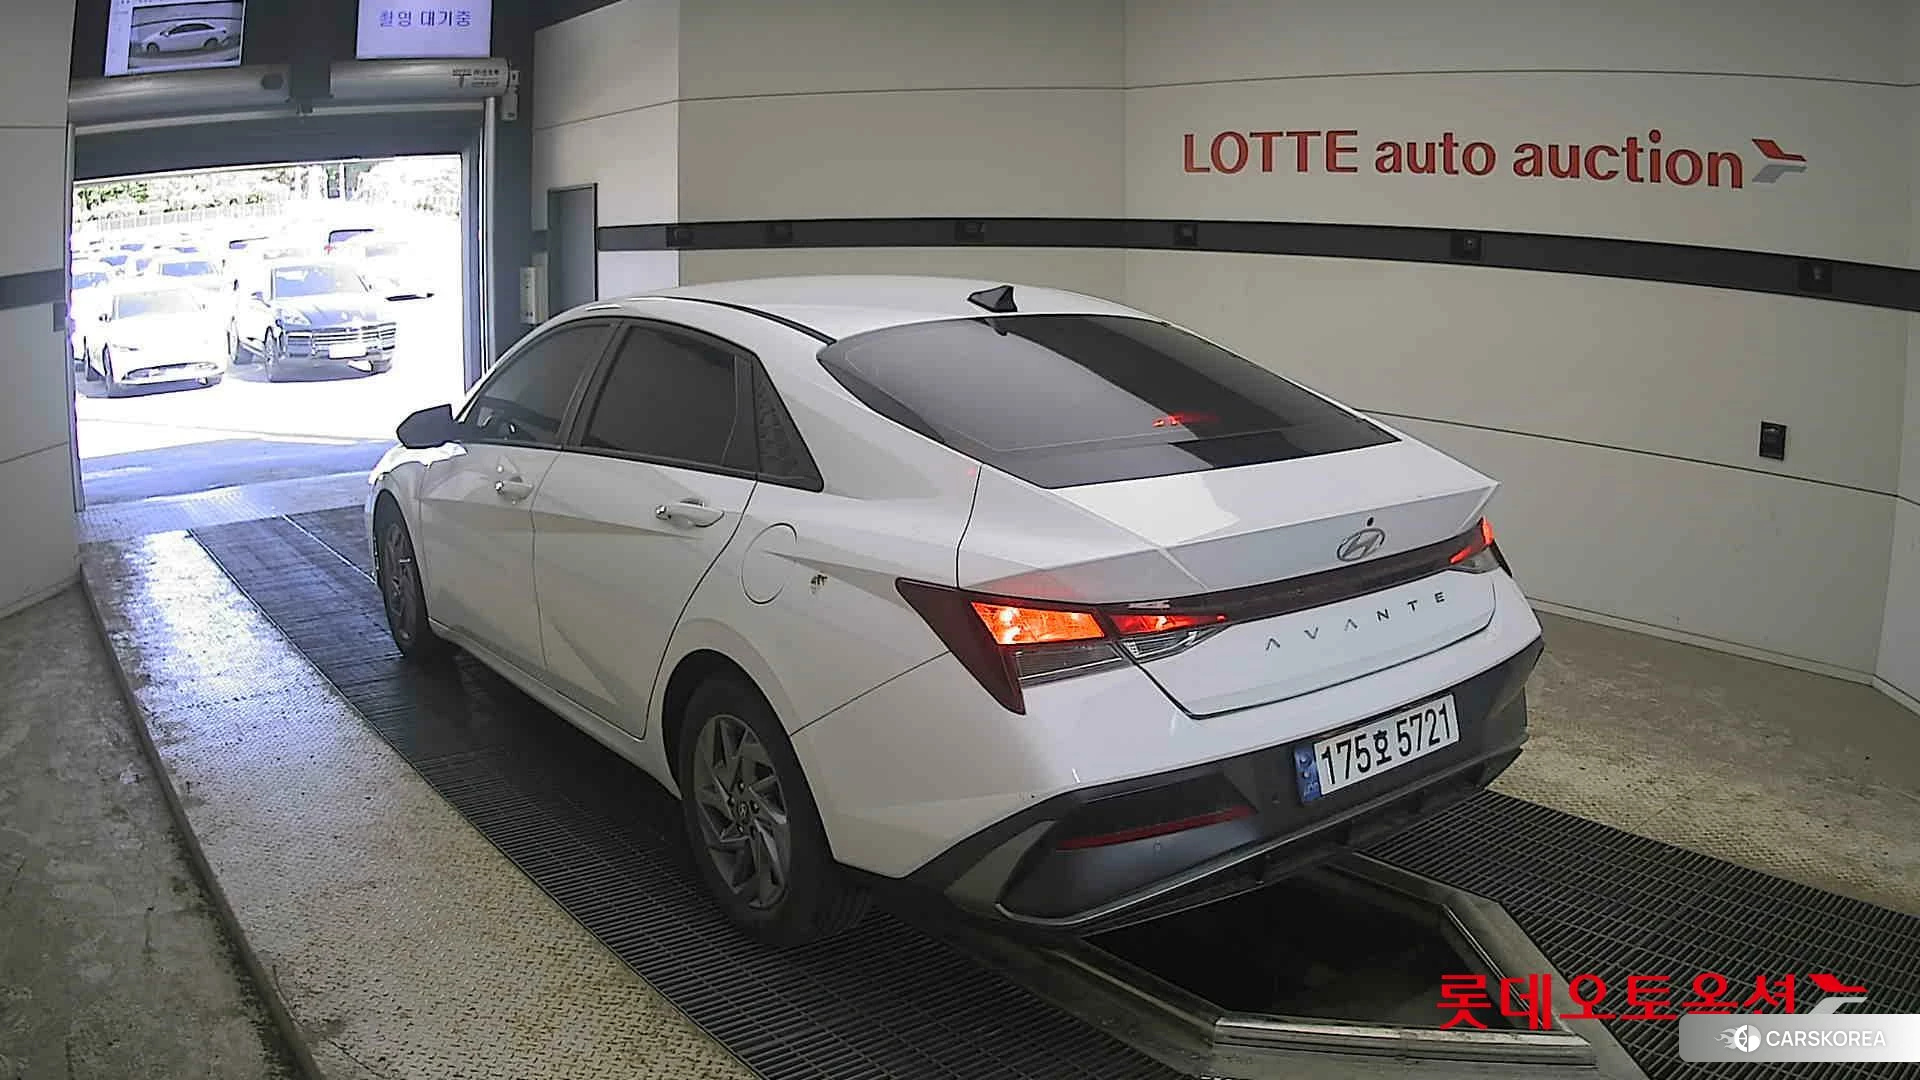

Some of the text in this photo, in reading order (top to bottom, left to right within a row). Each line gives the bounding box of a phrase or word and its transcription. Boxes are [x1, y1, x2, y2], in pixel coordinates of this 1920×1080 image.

[420, 10, 471, 27] 대기중
[1184, 129, 1744, 189] LOTTE auto auction
[1265, 591, 1447, 652] AVANTE
[1320, 702, 1451, 785] 175호 5721
